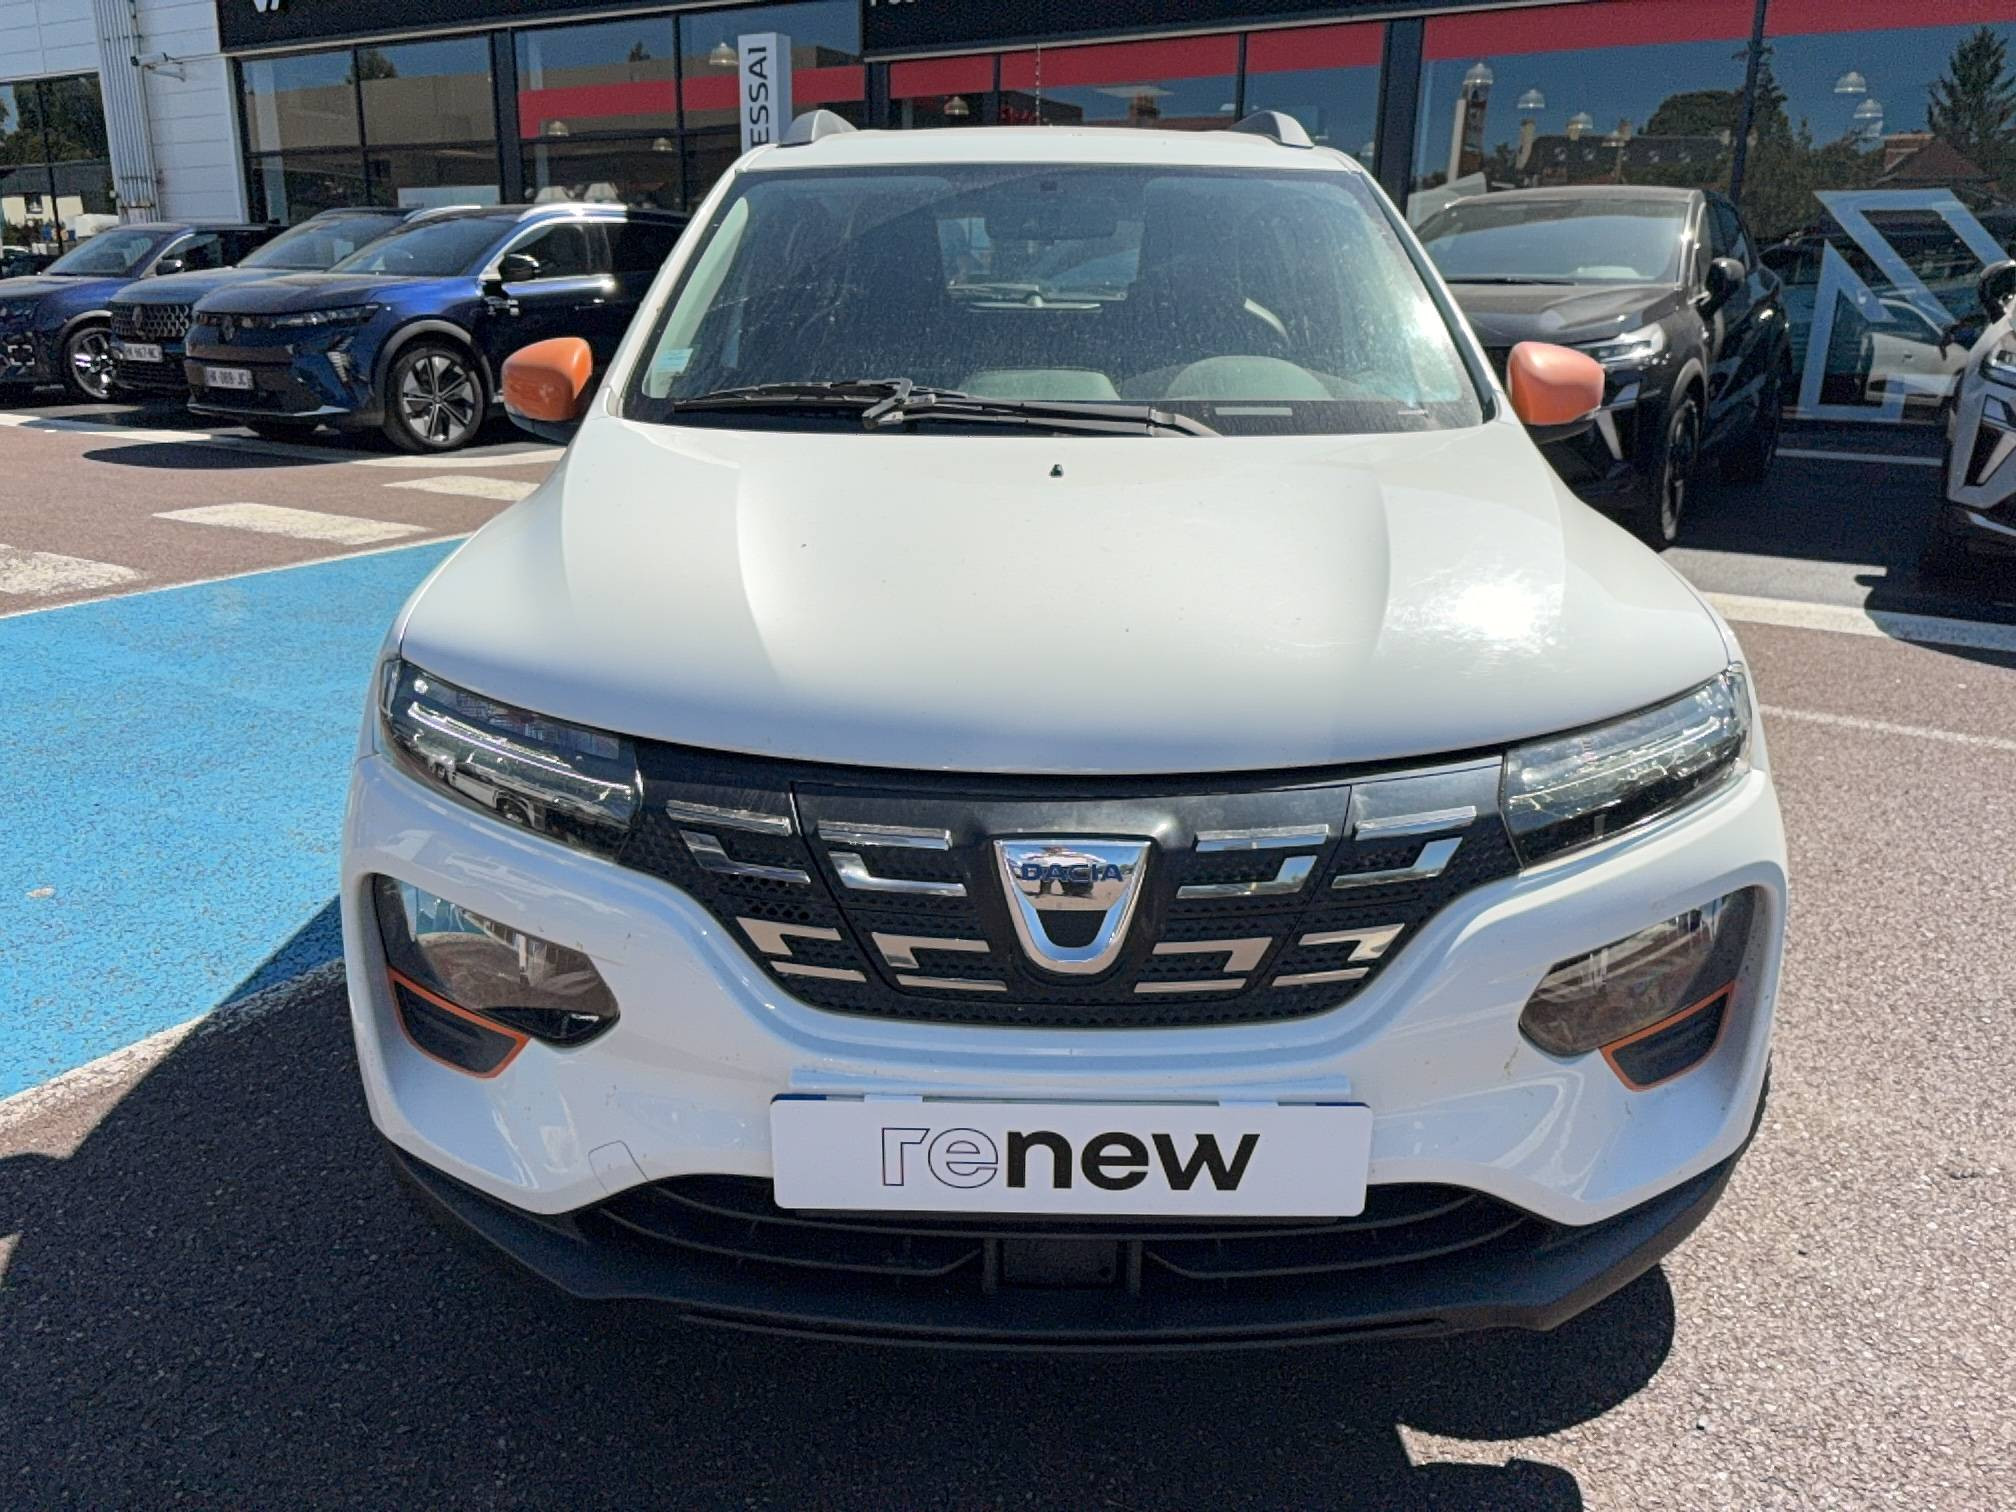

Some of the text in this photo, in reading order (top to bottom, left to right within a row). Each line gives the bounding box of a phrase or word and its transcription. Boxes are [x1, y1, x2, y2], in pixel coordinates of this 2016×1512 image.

[748, 47, 769, 146] ESSAI
[1021, 863, 1124, 881] DACIA
[881, 1127, 1260, 1191] renew
